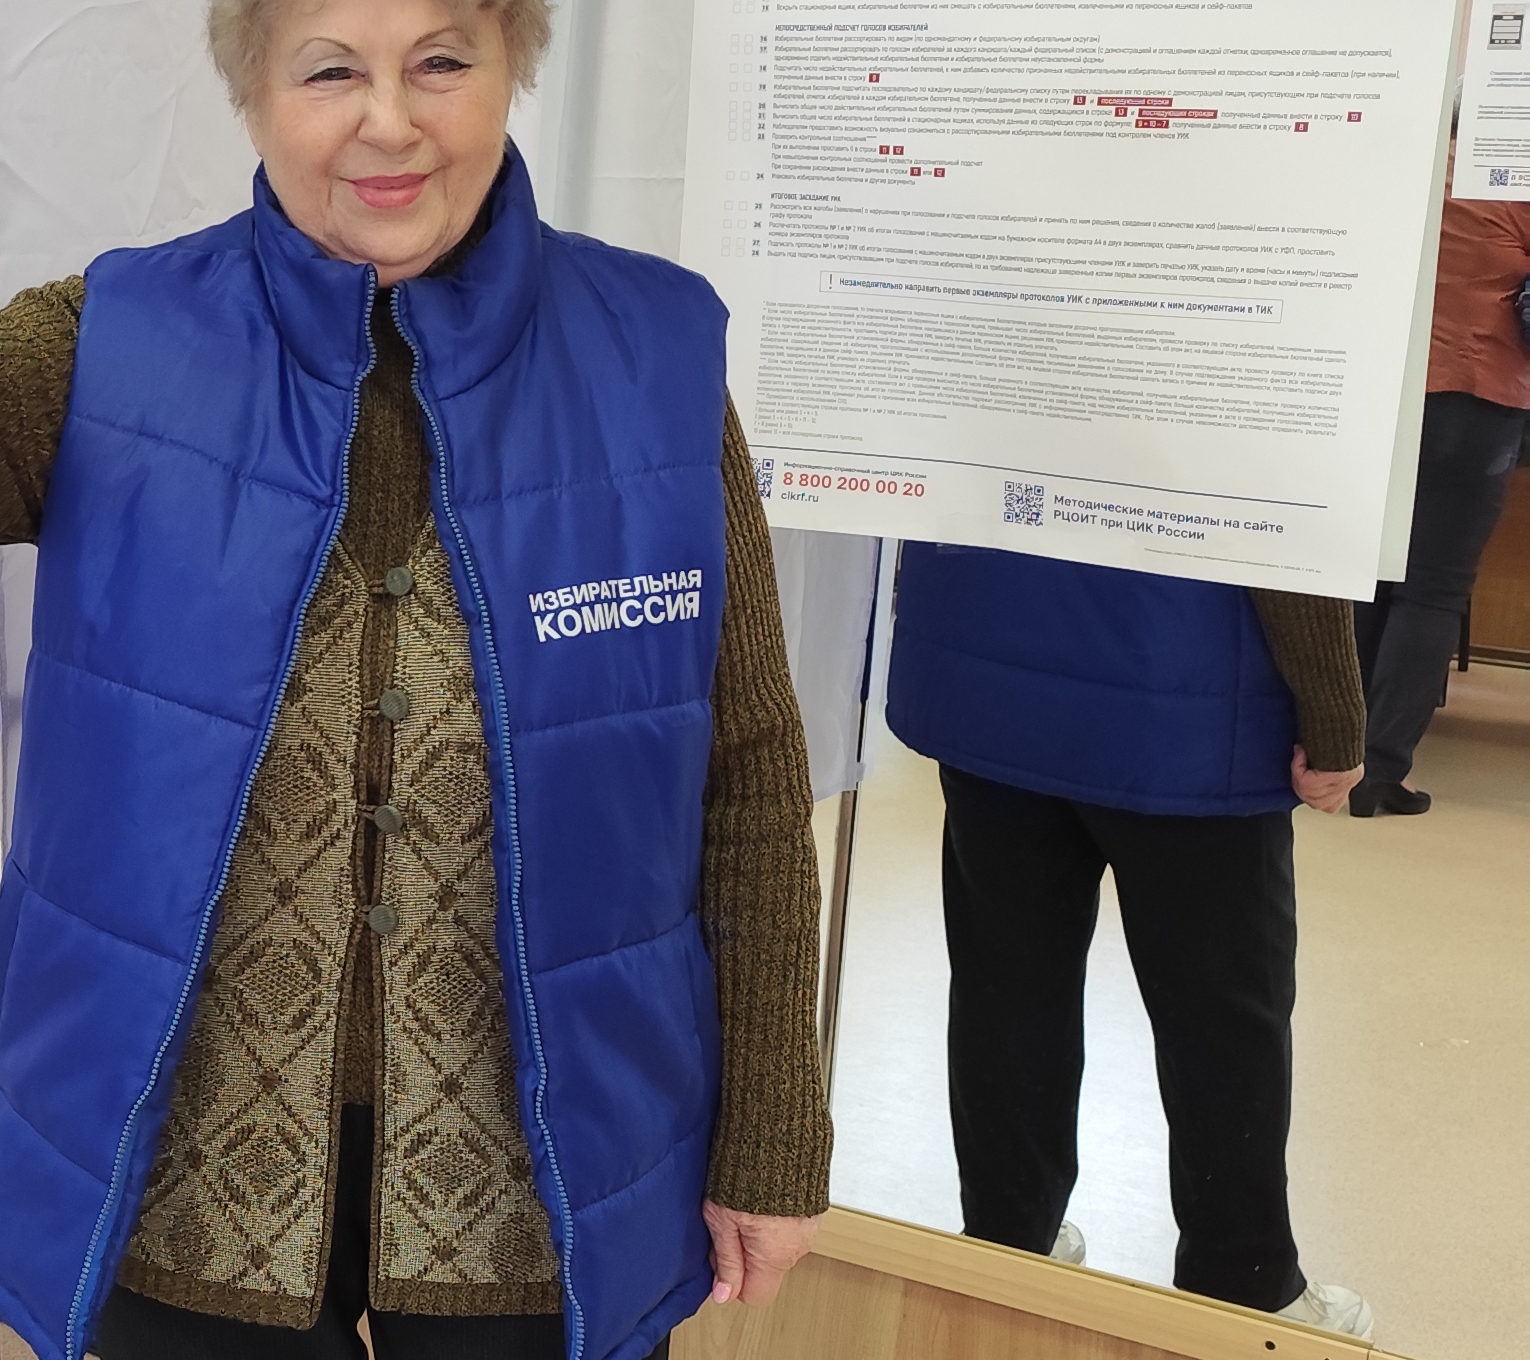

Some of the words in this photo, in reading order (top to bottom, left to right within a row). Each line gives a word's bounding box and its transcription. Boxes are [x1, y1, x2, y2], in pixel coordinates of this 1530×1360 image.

[839, 277, 903, 290] Незамедлительно
[904, 283, 942, 293] направить
[942, 286, 971, 296] первые
[971, 289, 1018, 300] экземпляры
[1019, 292, 1065, 303] протоколов
[1066, 294, 1083, 304] УИК
[1084, 296, 1090, 305] с
[1091, 297, 1158, 308] приложенными
[1159, 301, 1165, 309] к
[1167, 301, 1184, 309] ним
[1185, 302, 1246, 313] документами
[1255, 304, 1273, 315] ТИК
[782, 471, 793, 486] 8
[798, 473, 832, 489] 800
[836, 476, 870, 492] 200
[875, 479, 898, 495] 00
[902, 482, 925, 497] 20
[1053, 494, 1144, 516] Методические
[1146, 509, 1220, 526] материалы
[1223, 519, 1240, 528] на
[1243, 520, 1283, 533] сайте
[1053, 509, 1098, 524] РЦОИТ
[1100, 518, 1123, 530] при
[1126, 519, 1153, 534] ЦИК
[1157, 523, 1205, 540] России
[529, 569, 702, 613] ИЗБИРАТЕЛЬНАЯ
[533, 591, 700, 643] КОМИССИЯ
